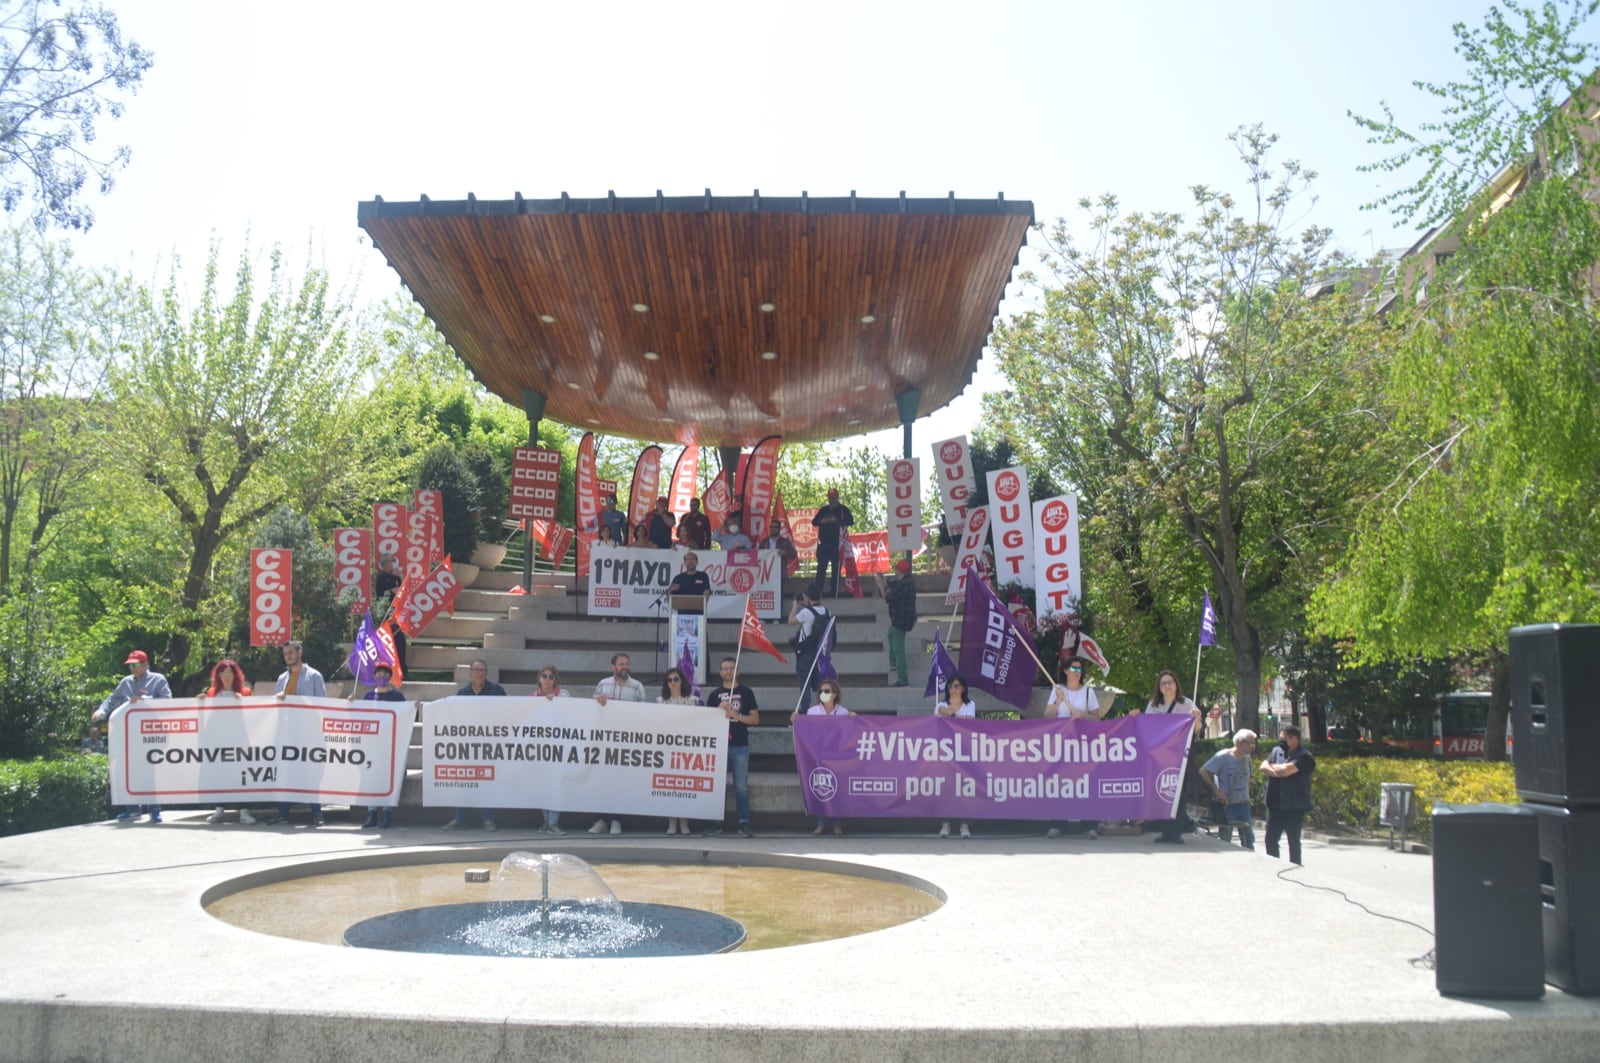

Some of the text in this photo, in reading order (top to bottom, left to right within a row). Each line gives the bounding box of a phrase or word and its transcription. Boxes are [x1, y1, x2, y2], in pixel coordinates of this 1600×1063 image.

[516, 450, 559, 463] CCOO
[514, 468, 557, 482] CCOO
[513, 486, 556, 500] CCOO
[579, 453, 599, 533] CCOO
[750, 457, 772, 536] CCOO
[945, 465, 968, 520] UGT
[511, 504, 554, 518] CCOO
[895, 485, 912, 537] UGT
[1000, 504, 1024, 574] UGT
[1045, 535, 1069, 610] UGT
[325, 734, 361, 744] ciudad real
[434, 725, 717, 749] LABORALES Y PERSONAL INTERINO DOCENTE
[1448, 739, 1484, 753] AIB
[856, 731, 1137, 763] #VivasLibresUnidas
[146, 745, 372, 769] CONVENIO DIGNO,
[434, 742, 716, 772] CONTRATACION A 12 MESES ¡¡YA!!
[241, 767, 278, 786] ¡YA!
[434, 780, 479, 788] enseñanza
[812, 773, 833, 786] UGT
[652, 790, 697, 799] enseñanza
[853, 781, 894, 792] CCOO
[905, 772, 1090, 802] por la igualdad
[1102, 782, 1141, 794] CCOO
